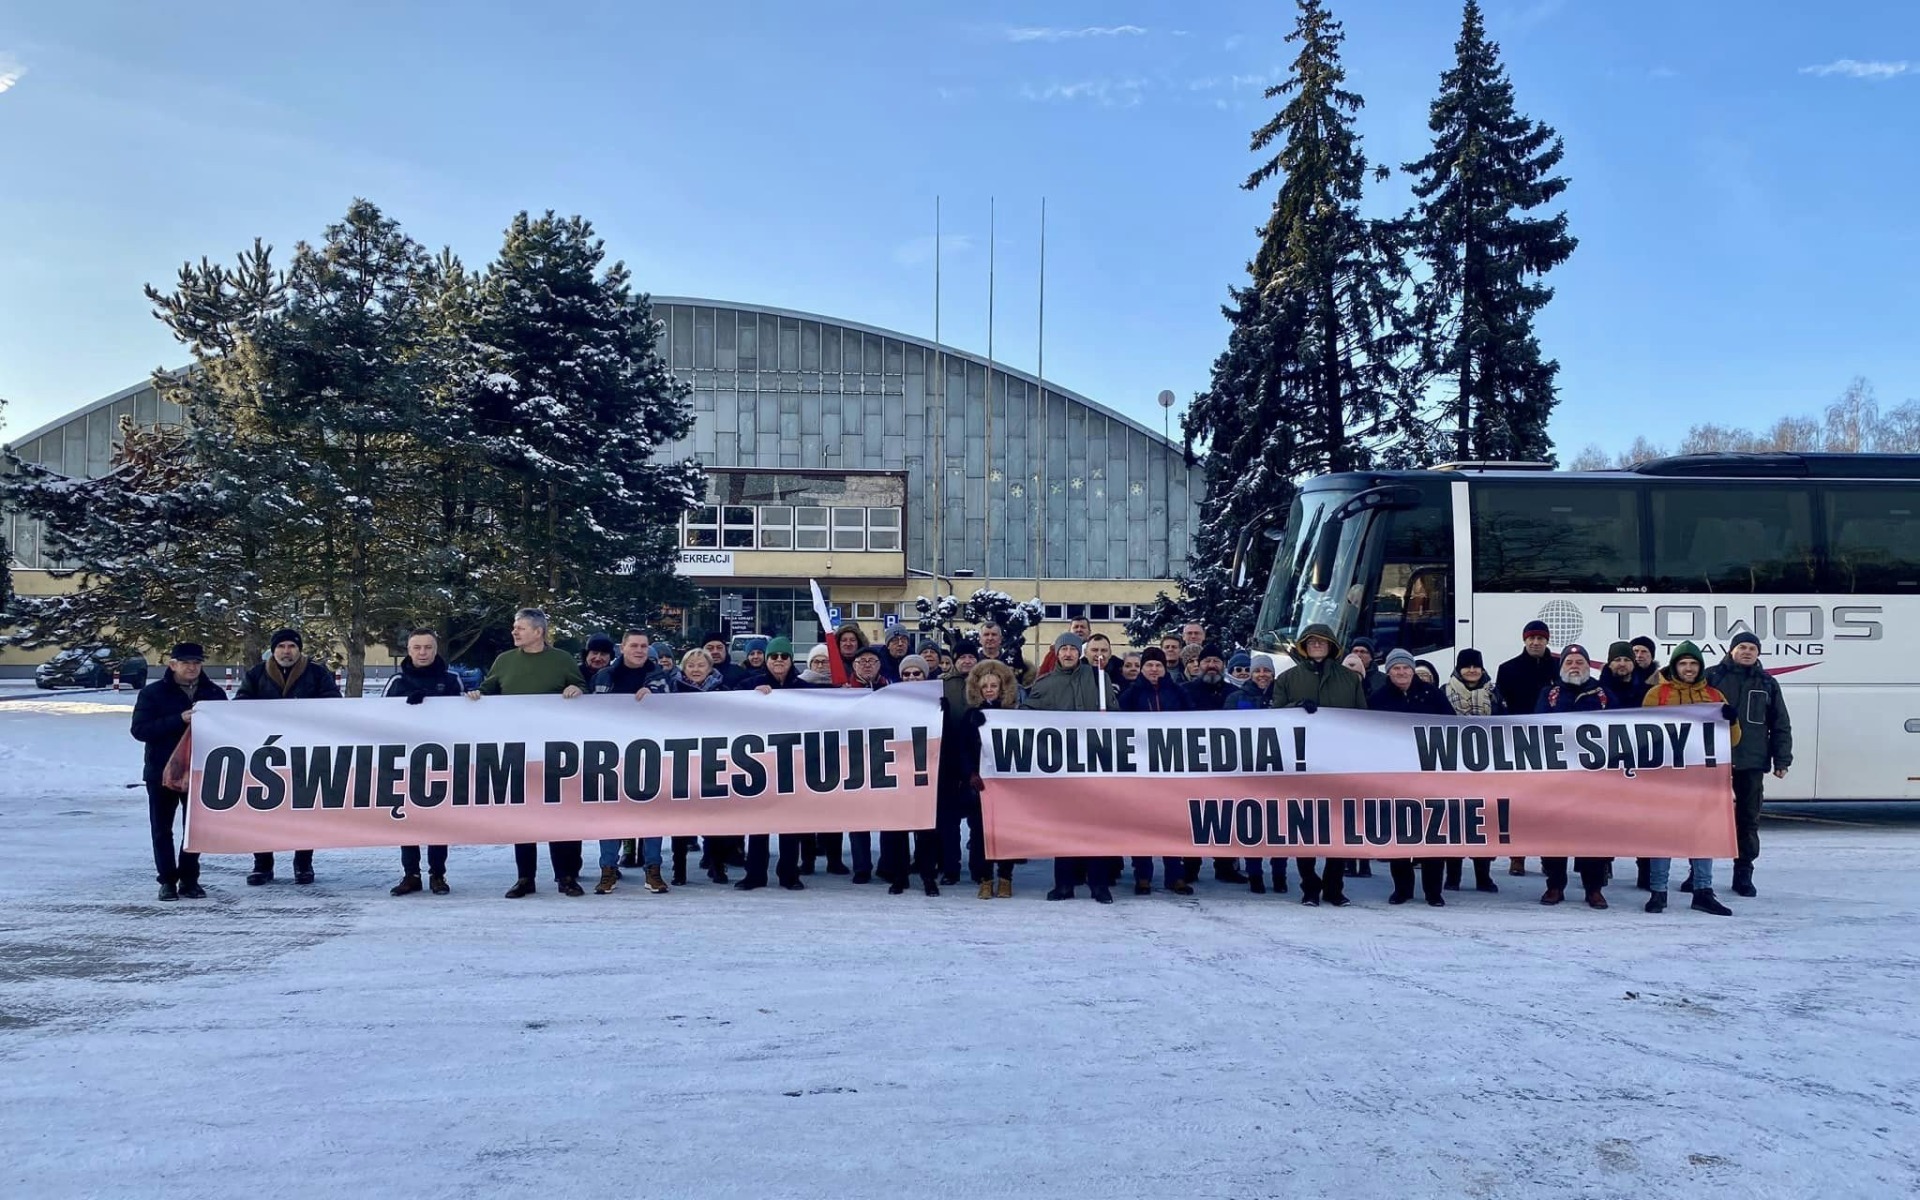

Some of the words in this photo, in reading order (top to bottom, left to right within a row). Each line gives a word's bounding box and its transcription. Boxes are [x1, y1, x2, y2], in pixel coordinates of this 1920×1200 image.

[829, 608, 838, 620] P
[886, 615, 896, 627] P
[1600, 605, 1883, 641] TOWOS
[1661, 643, 1824, 656] TAVLING
[991, 727, 1137, 773] WOLNE
[1147, 727, 1284, 772] MEDIA
[1413, 724, 1568, 772] WOLNE
[1575, 722, 1693, 778] SĄDY
[200, 735, 526, 819] OŚWIĘCIM
[543, 727, 898, 803] PROTESTUJE
[1187, 798, 1331, 846] WOLNI
[1343, 798, 1488, 846] LUDZIE
